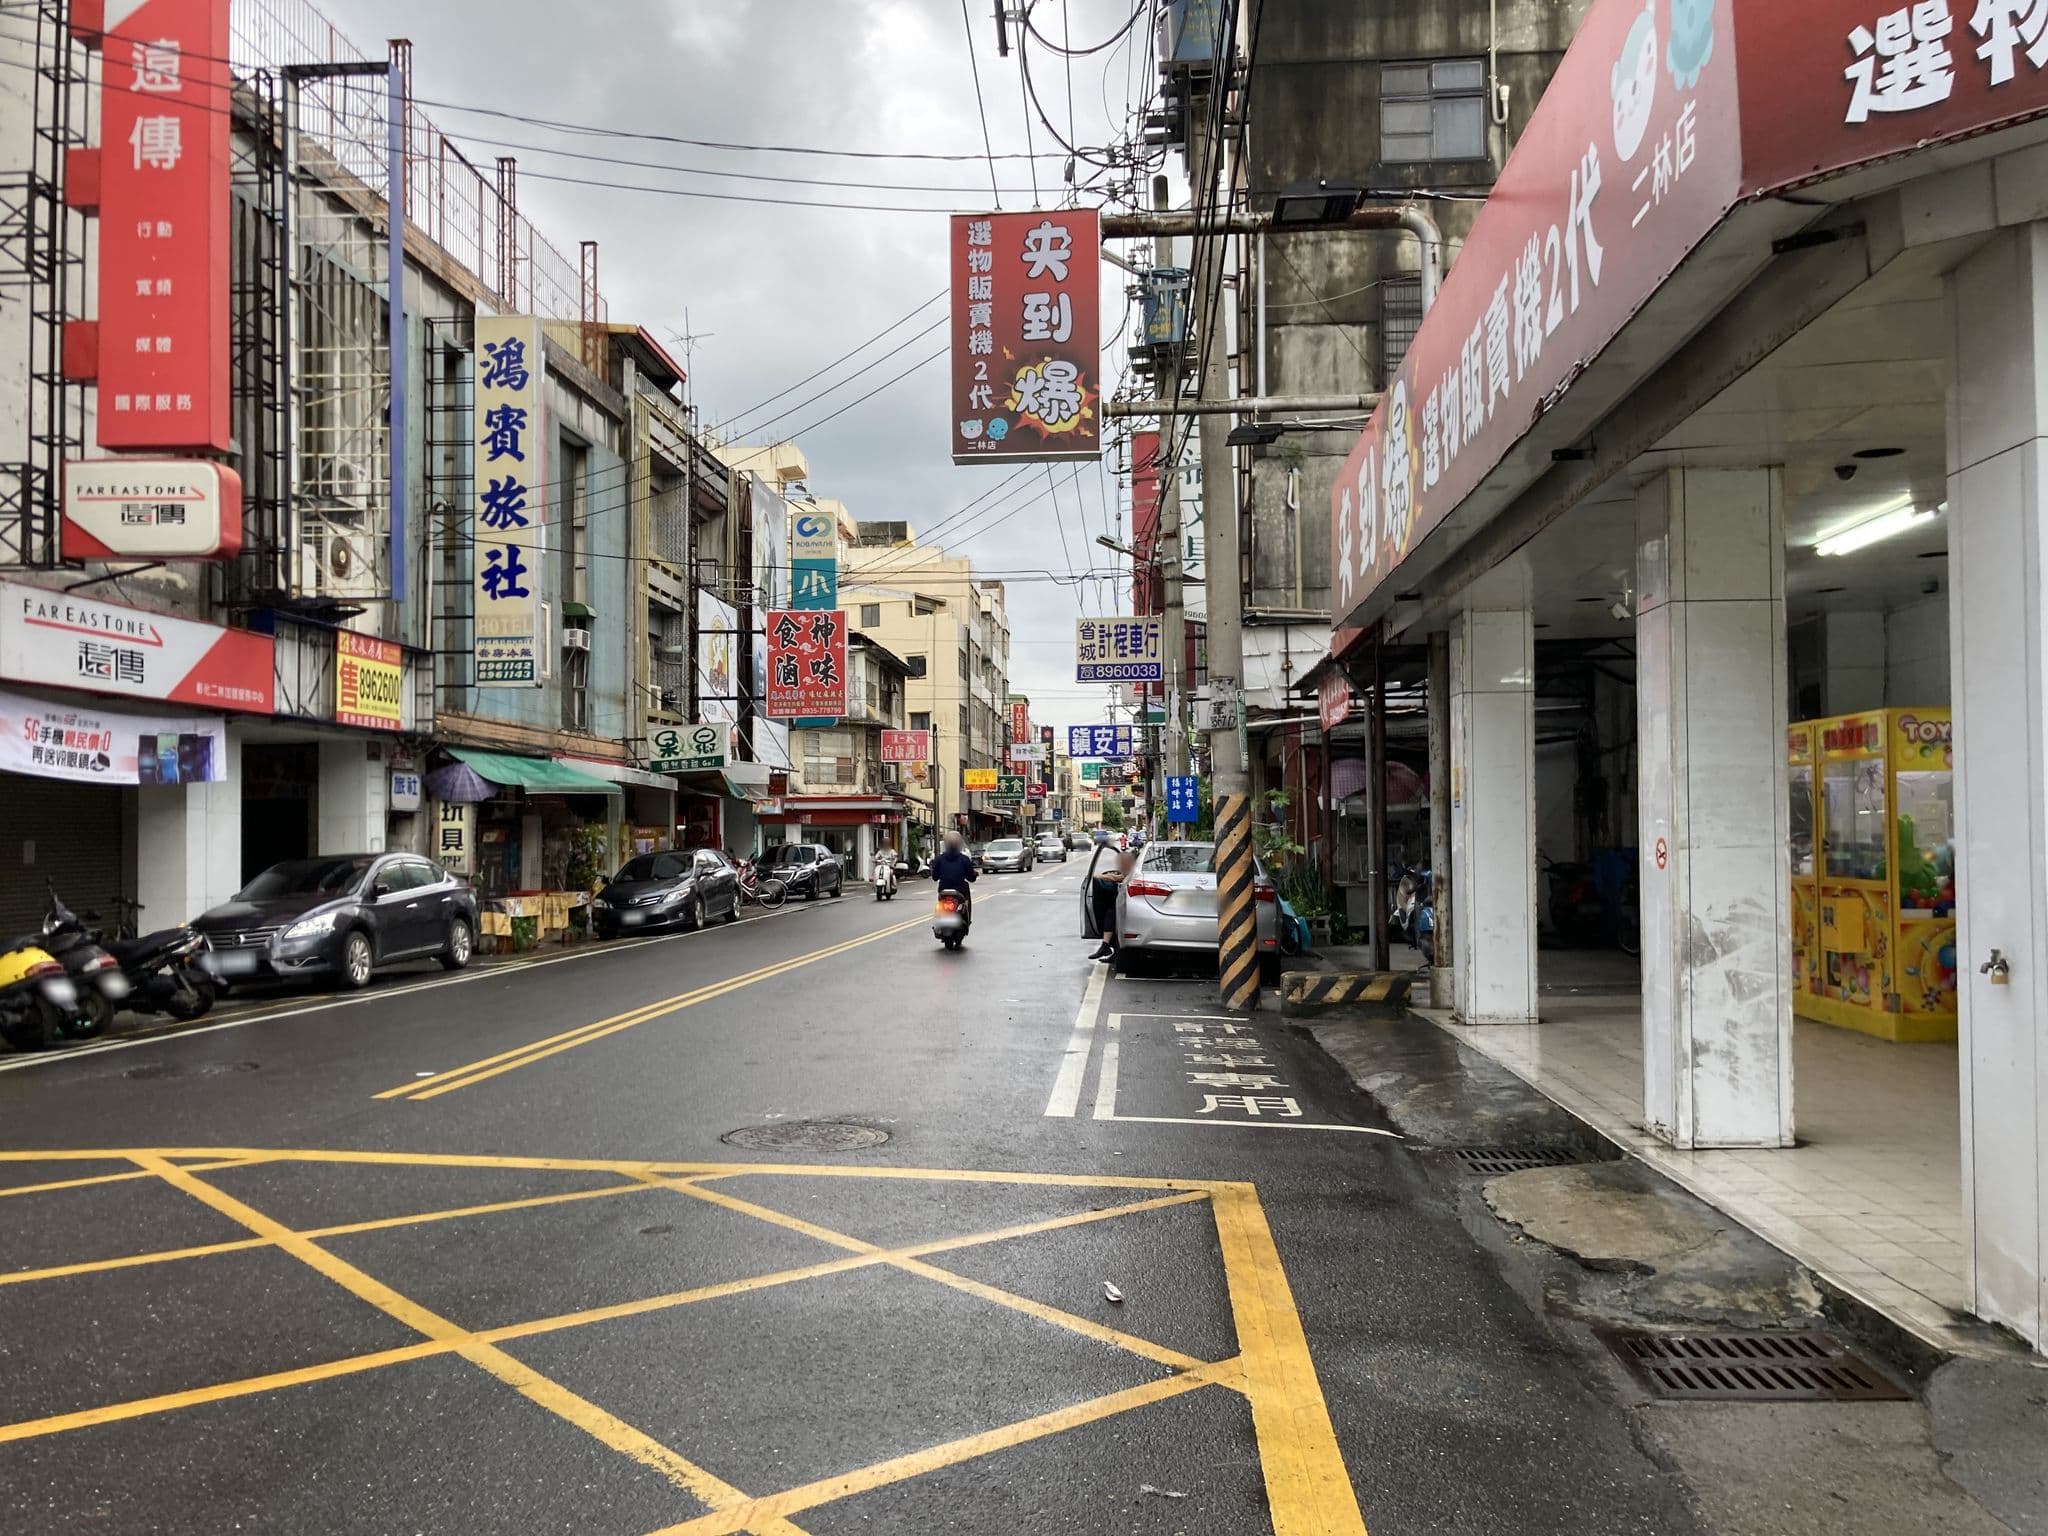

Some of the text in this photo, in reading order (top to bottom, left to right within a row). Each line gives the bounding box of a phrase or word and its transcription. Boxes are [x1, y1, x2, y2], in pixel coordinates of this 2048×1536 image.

[129, 40, 182, 170] 遠傳
[1631, 99, 1697, 228] 二林店
[137, 221, 173, 238] 行動
[136, 279, 172, 296] 寬頻
[967, 220, 993, 411] 選物販賣機2代
[1420, 140, 1603, 494] 選物販賣機2代
[136, 336, 172, 353] 媒體
[115, 394, 193, 412] 國際服務
[967, 440, 997, 450] 二林店
[480, 336, 531, 601] 鴻賓旅社
[77, 485, 188, 498] FAREASTONE
[121, 503, 186, 526] 遠傳
[23, 597, 147, 637] FAREASTONE
[1098, 622, 1159, 659] 計程車行
[78, 640, 145, 685] 遠傳
[479, 661, 532, 671] 8961142
[1096, 665, 1158, 678] 8960038
[339, 658, 359, 710] 售
[359, 667, 400, 706] 8962600
[479, 670, 532, 680] 8961143
[394, 775, 419, 796] 旅社
